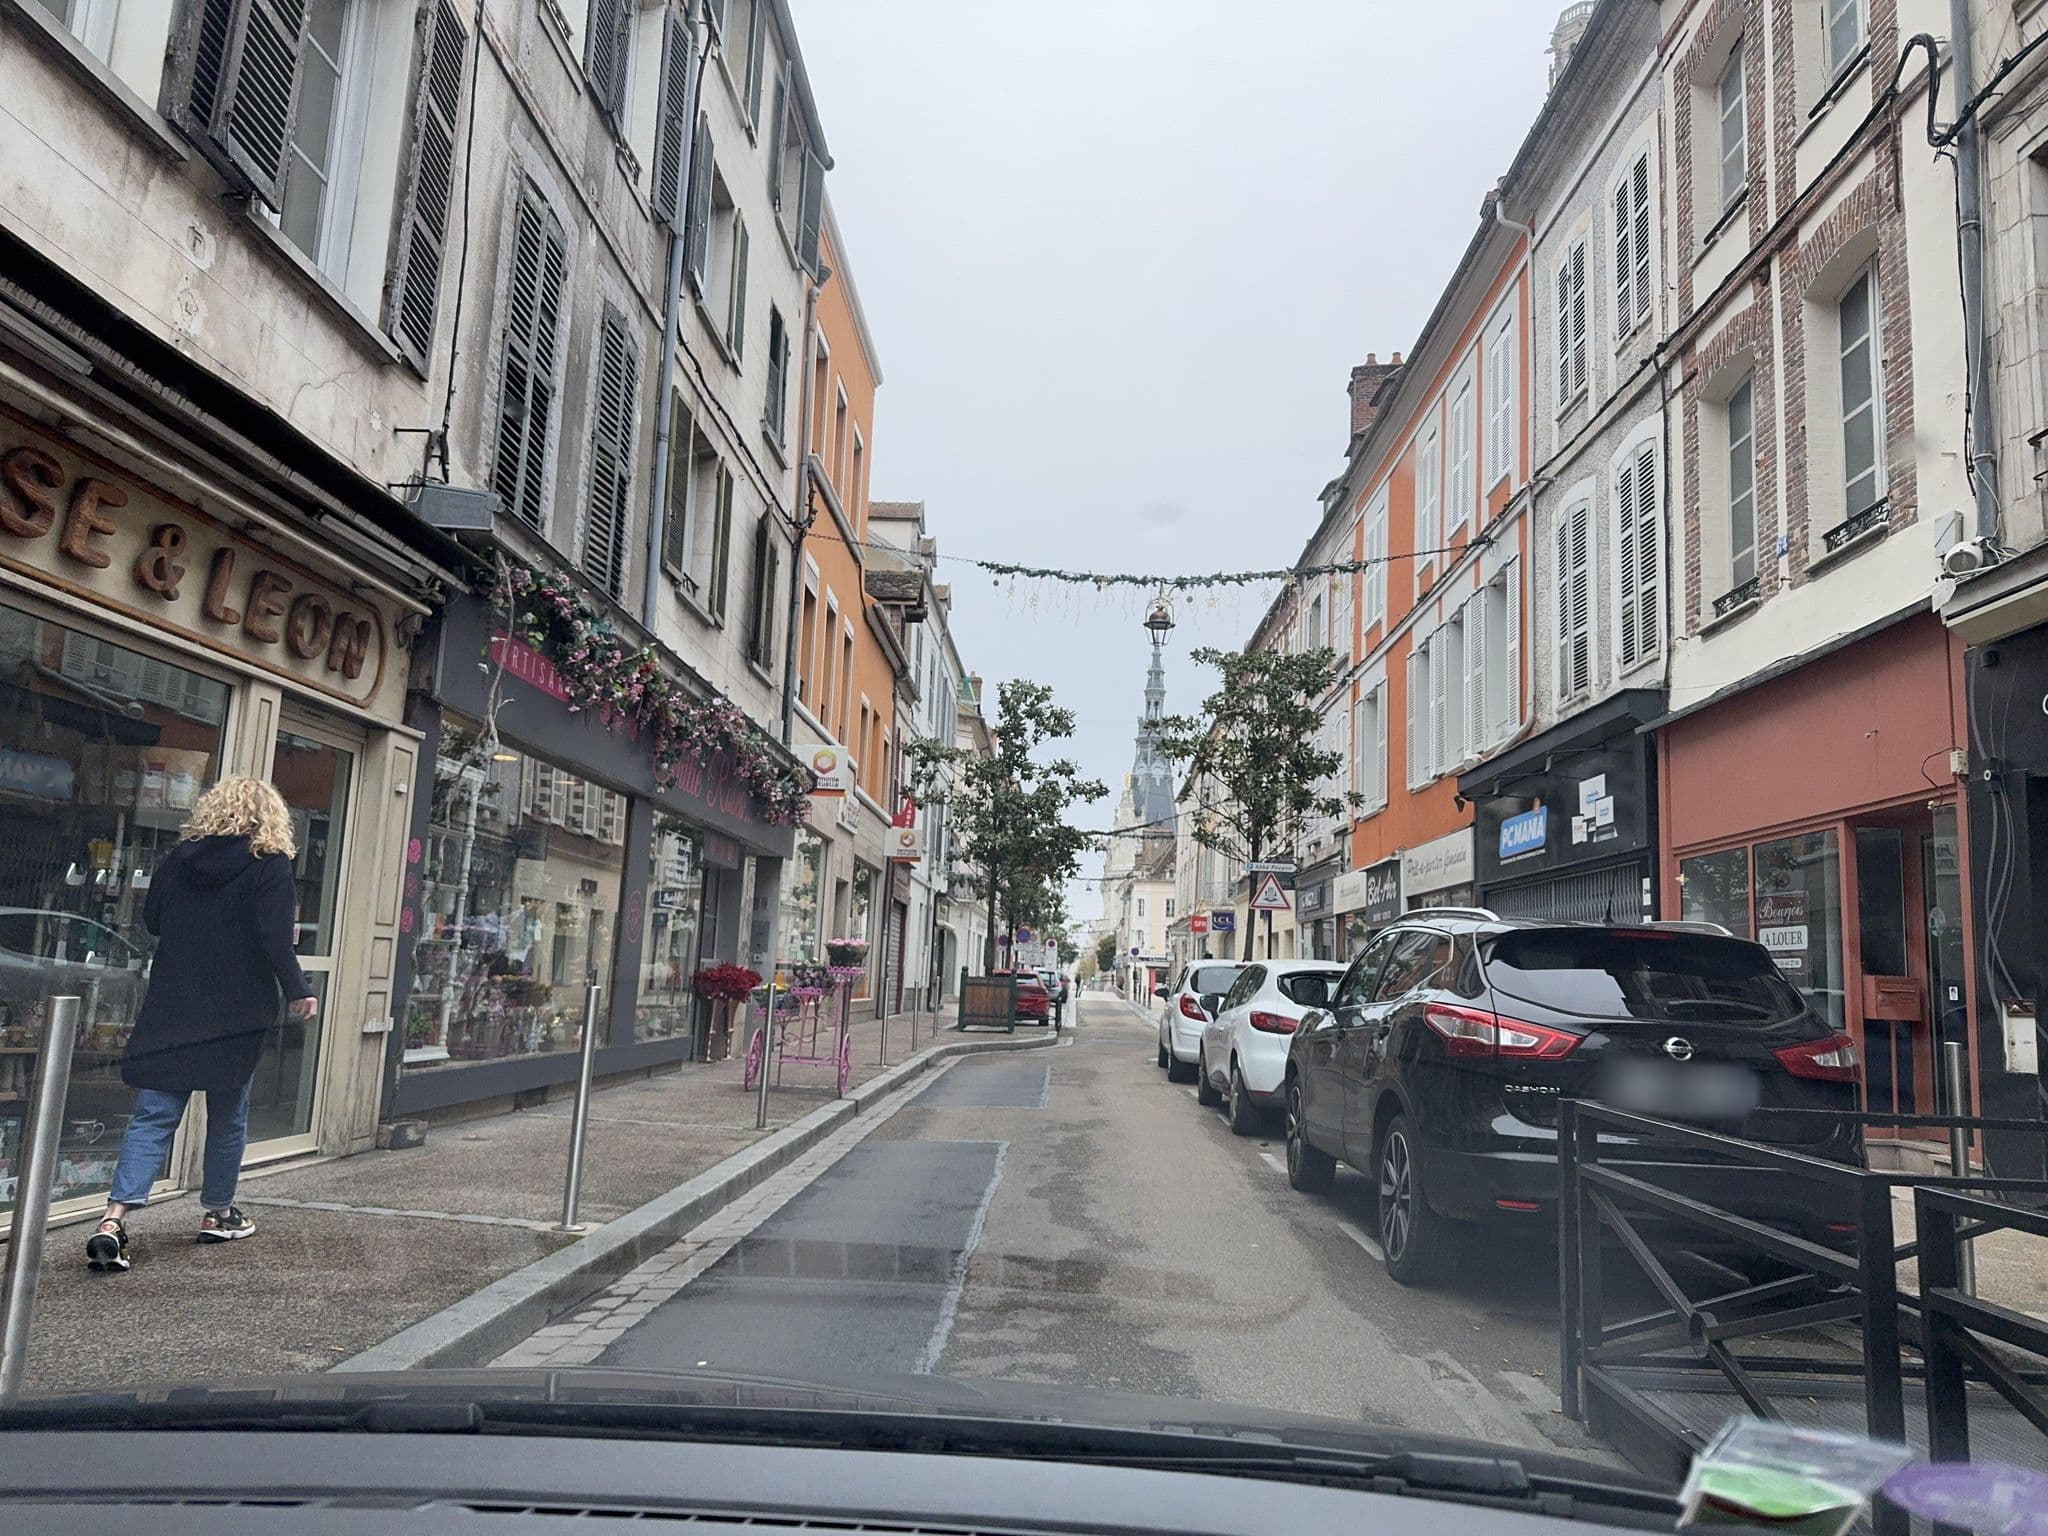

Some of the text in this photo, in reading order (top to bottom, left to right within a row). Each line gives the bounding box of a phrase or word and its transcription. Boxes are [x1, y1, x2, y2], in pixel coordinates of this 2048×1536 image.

[133, 523, 188, 602] &
[203, 546, 372, 681] LEON
[1213, 915, 1232, 923] LCL
[1765, 931, 1804, 946] A LOUER
